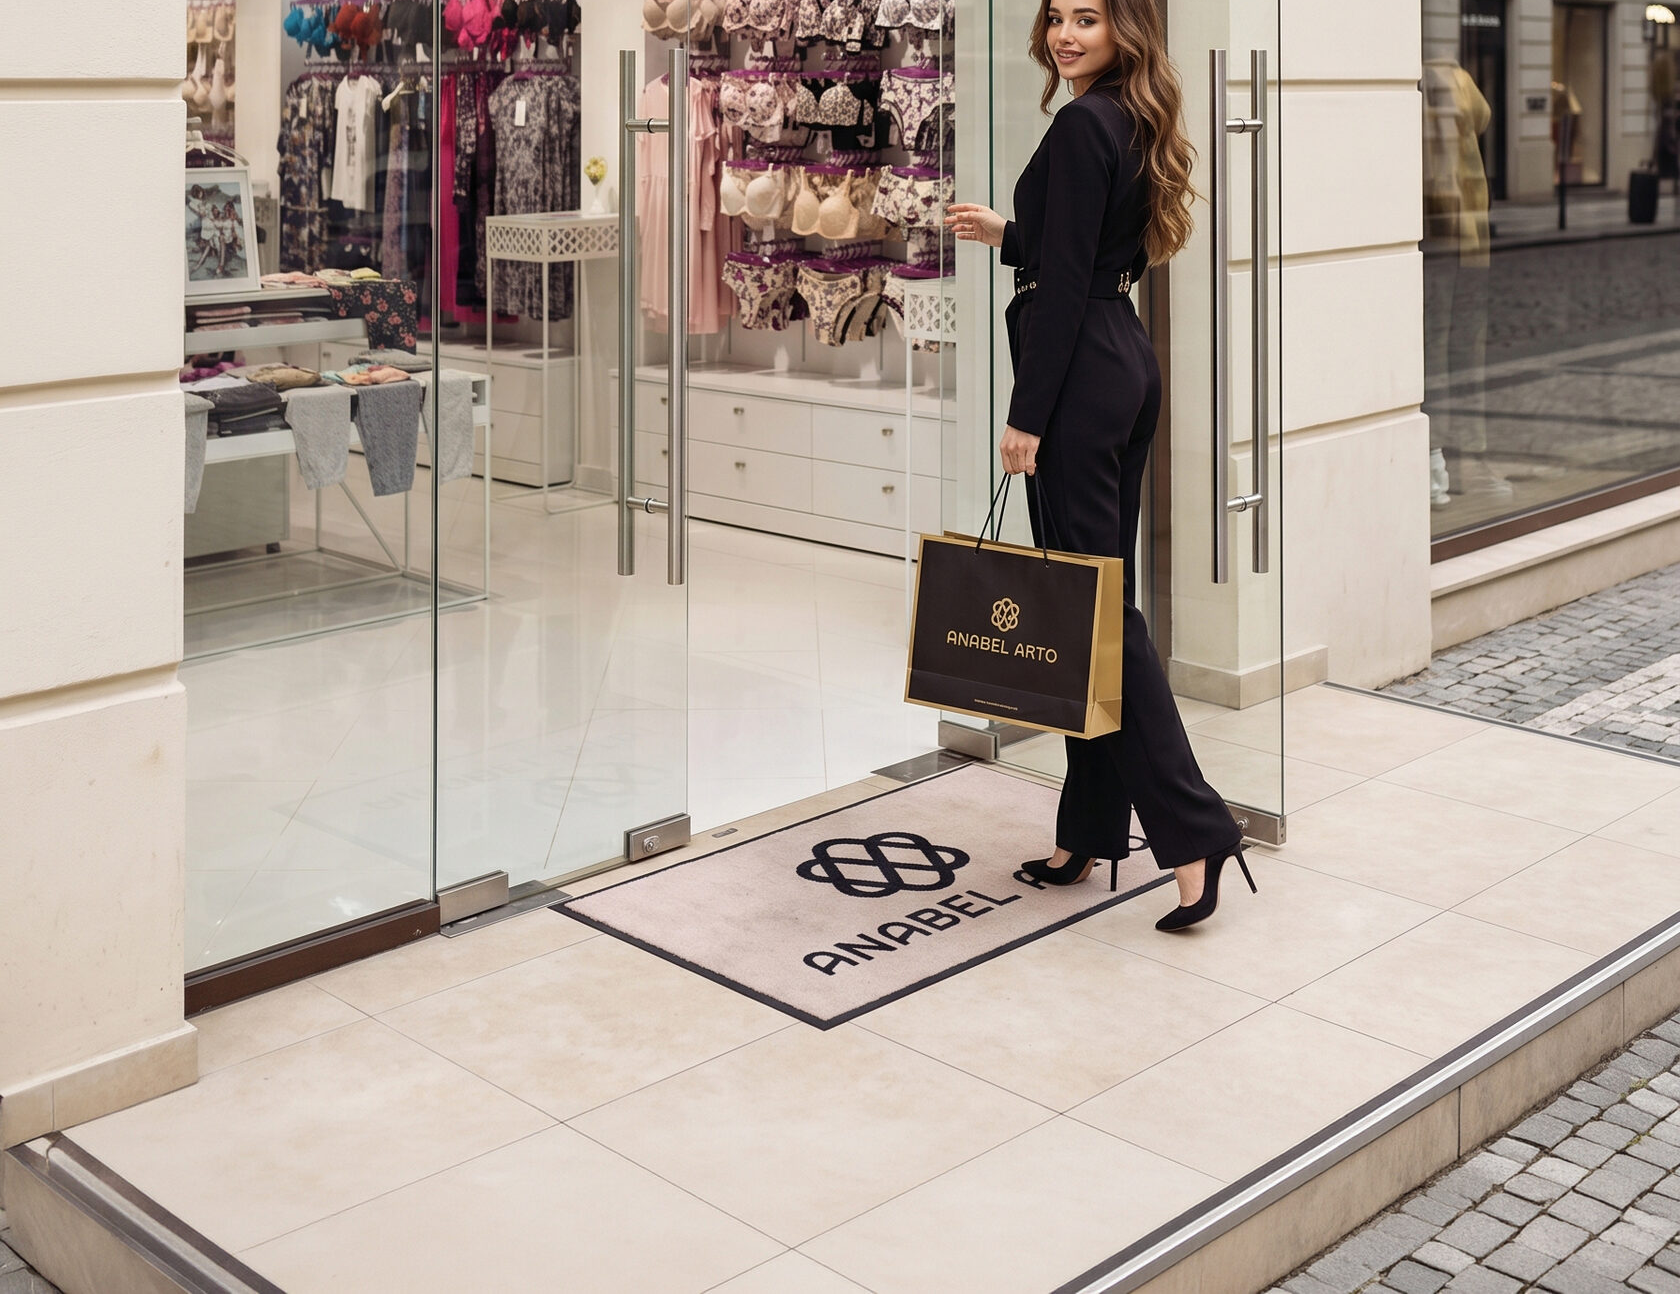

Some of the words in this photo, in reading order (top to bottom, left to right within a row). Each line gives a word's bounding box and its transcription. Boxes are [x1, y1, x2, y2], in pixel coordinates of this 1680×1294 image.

[946, 630, 1009, 655] ANABEL
[1013, 642, 1058, 664] ARTO
[802, 888, 1023, 976] ANABEL
